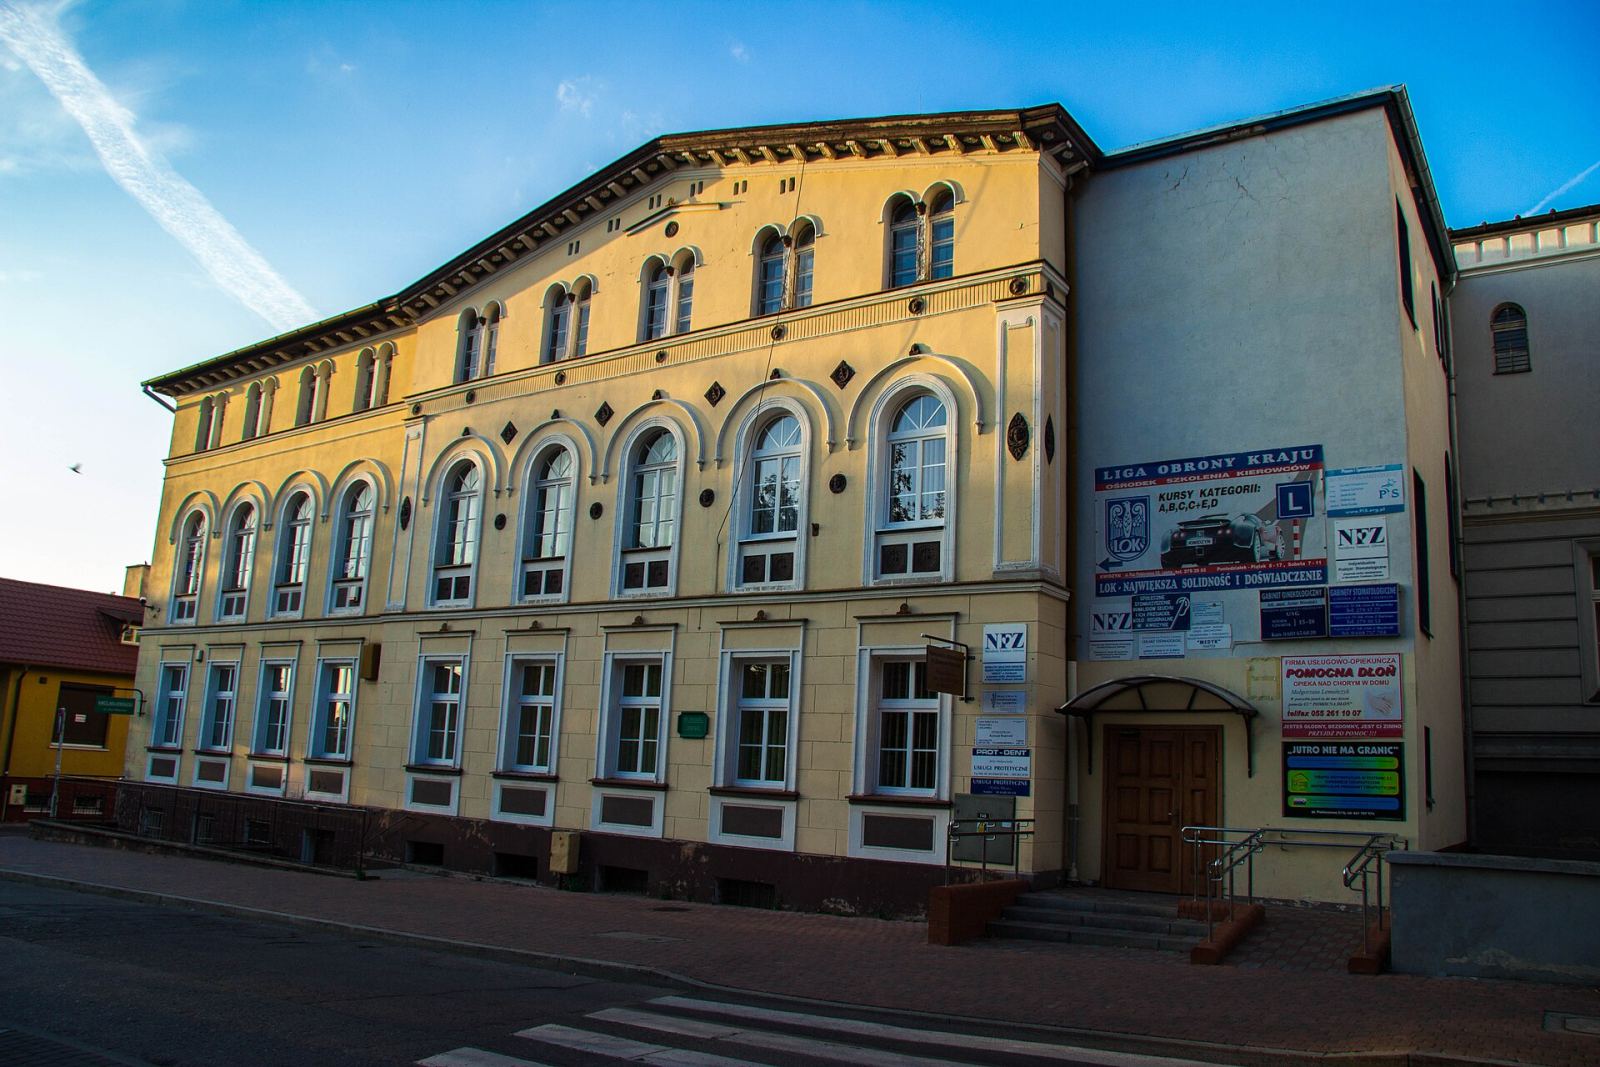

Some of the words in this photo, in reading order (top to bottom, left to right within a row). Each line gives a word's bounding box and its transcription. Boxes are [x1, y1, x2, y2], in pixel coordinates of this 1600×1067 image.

[1103, 467, 1147, 480] LIGA
[1158, 457, 1236, 475] OBRONY
[1247, 449, 1314, 465] KRAJU
[1105, 480, 1157, 490] OŚRODEK
[1166, 473, 1230, 484] SZKOLENIA
[1236, 464, 1311, 477] KIEROWCÓW
[1158, 490, 1194, 502] KURSY
[1199, 484, 1261, 498] KATEGORII:
[1287, 492, 1303, 511] L
[1337, 526, 1385, 546] NFZ
[1114, 538, 1141, 553] LOK
[1100, 583, 1117, 593] LOK
[1123, 579, 1178, 593] NAJWIĘKSZA
[1182, 573, 1231, 588] SOLIDNOŚĆ
[1235, 576, 1240, 585] I
[1244, 570, 1323, 585] DOŚWIADCZENIE
[1092, 612, 1132, 631] NFZ
[985, 632, 1025, 650] NFZ
[1308, 656, 1396, 666] USŁUGOWO-OPIEKUŃCZA
[1285, 668, 1354, 679] POMOCNA
[1357, 664, 1397, 678] DŁOŃ
[1322, 746, 1338, 754] NIE
[1340, 746, 1355, 754] MA
